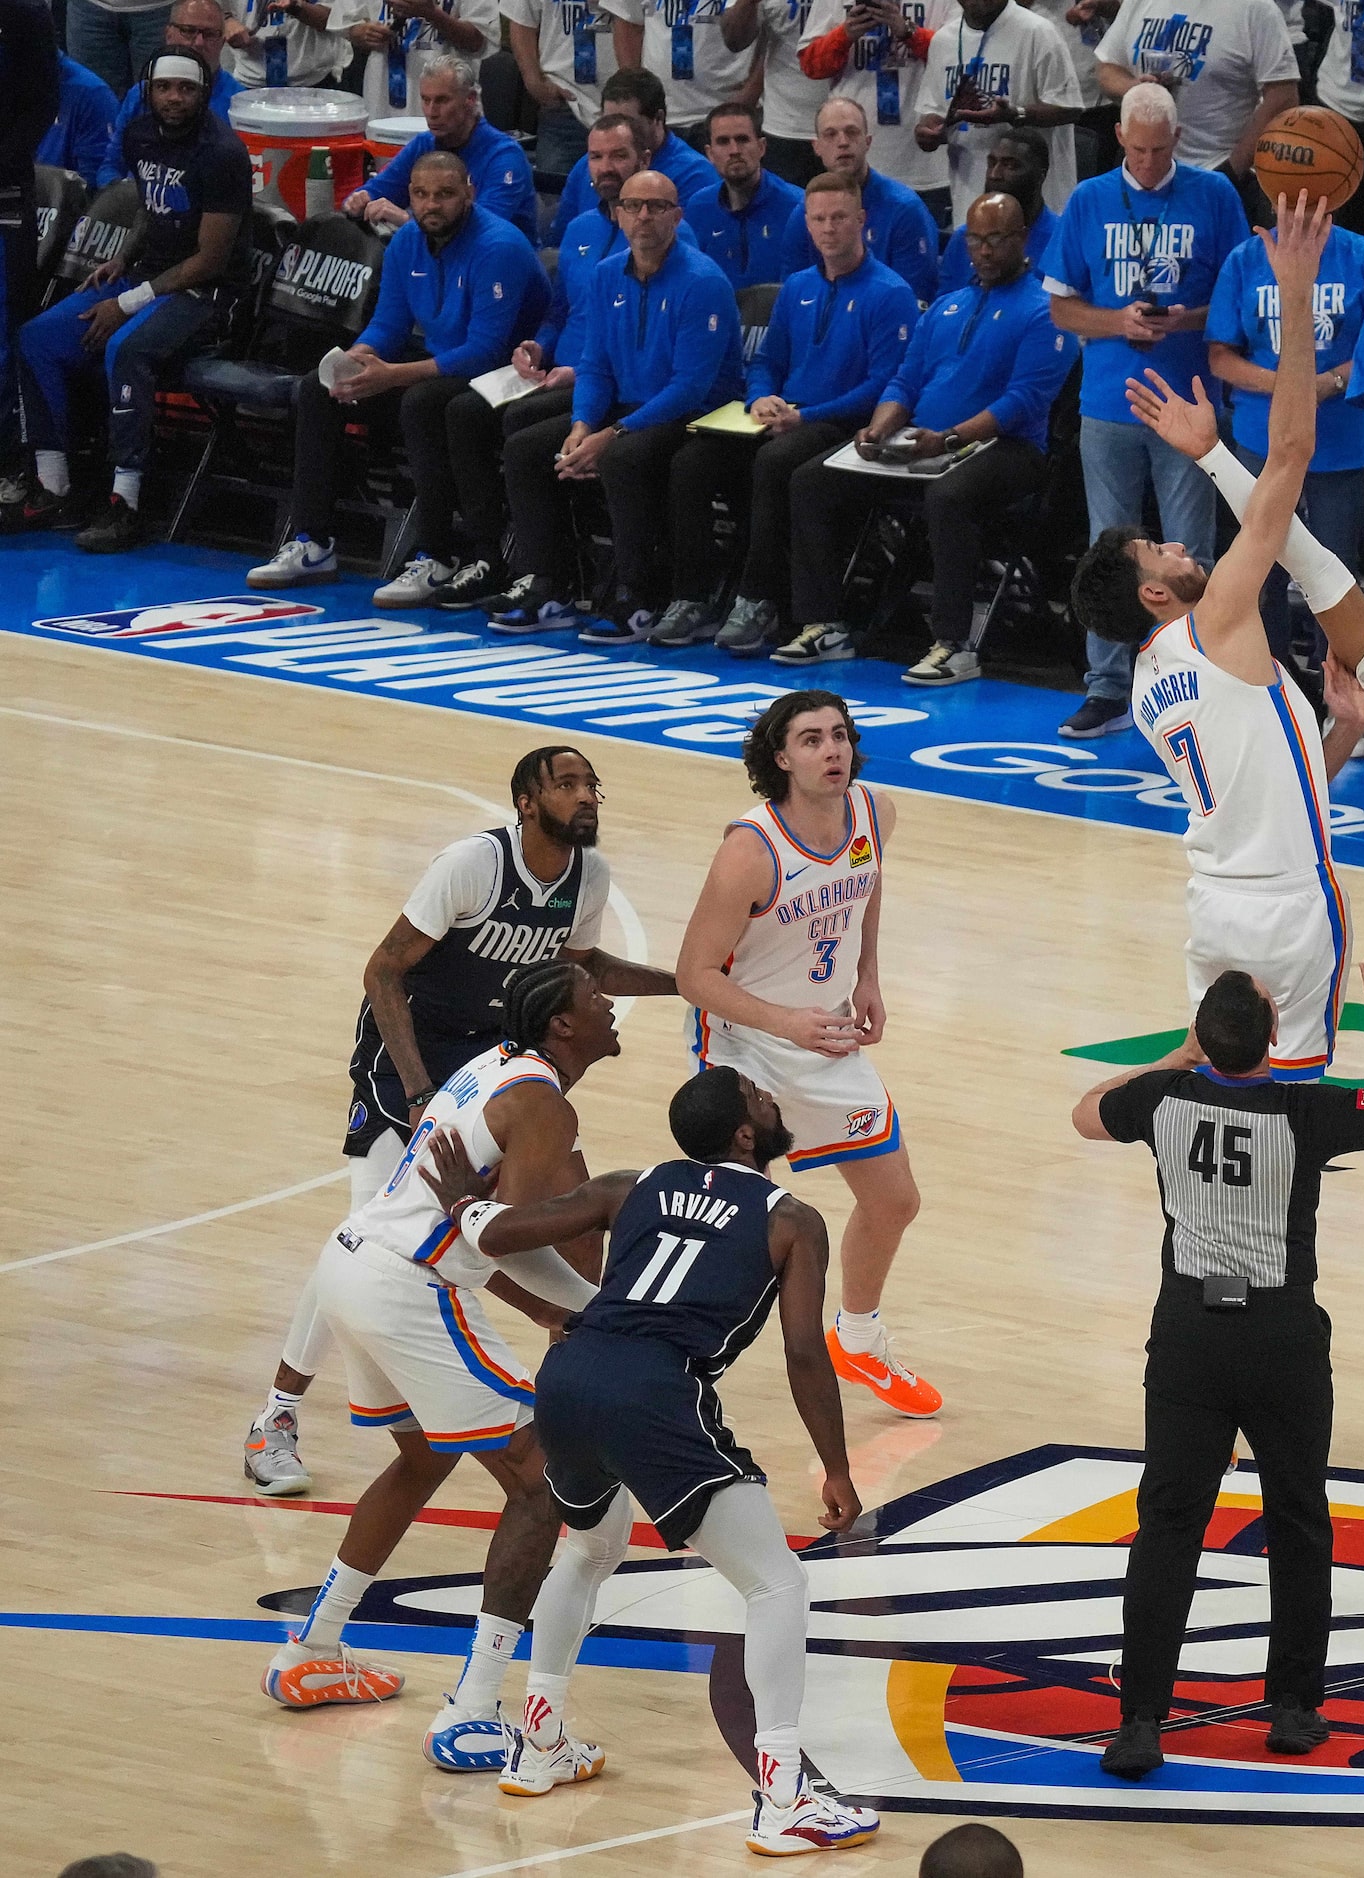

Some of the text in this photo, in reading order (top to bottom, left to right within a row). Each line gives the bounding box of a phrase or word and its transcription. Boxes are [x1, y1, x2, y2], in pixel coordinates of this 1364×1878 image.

[1104, 222, 1194, 259] THUNDER
[292, 248, 373, 300] PLAYOFFS
[1114, 261, 1139, 297] UP
[1163, 720, 1216, 817] 7
[468, 919, 571, 965] MAVS
[808, 905, 853, 941] CITY
[808, 936, 841, 984] 3
[1189, 1120, 1251, 1187] 45
[658, 1190, 739, 1230] IRVING
[625, 1231, 706, 1304] 11
